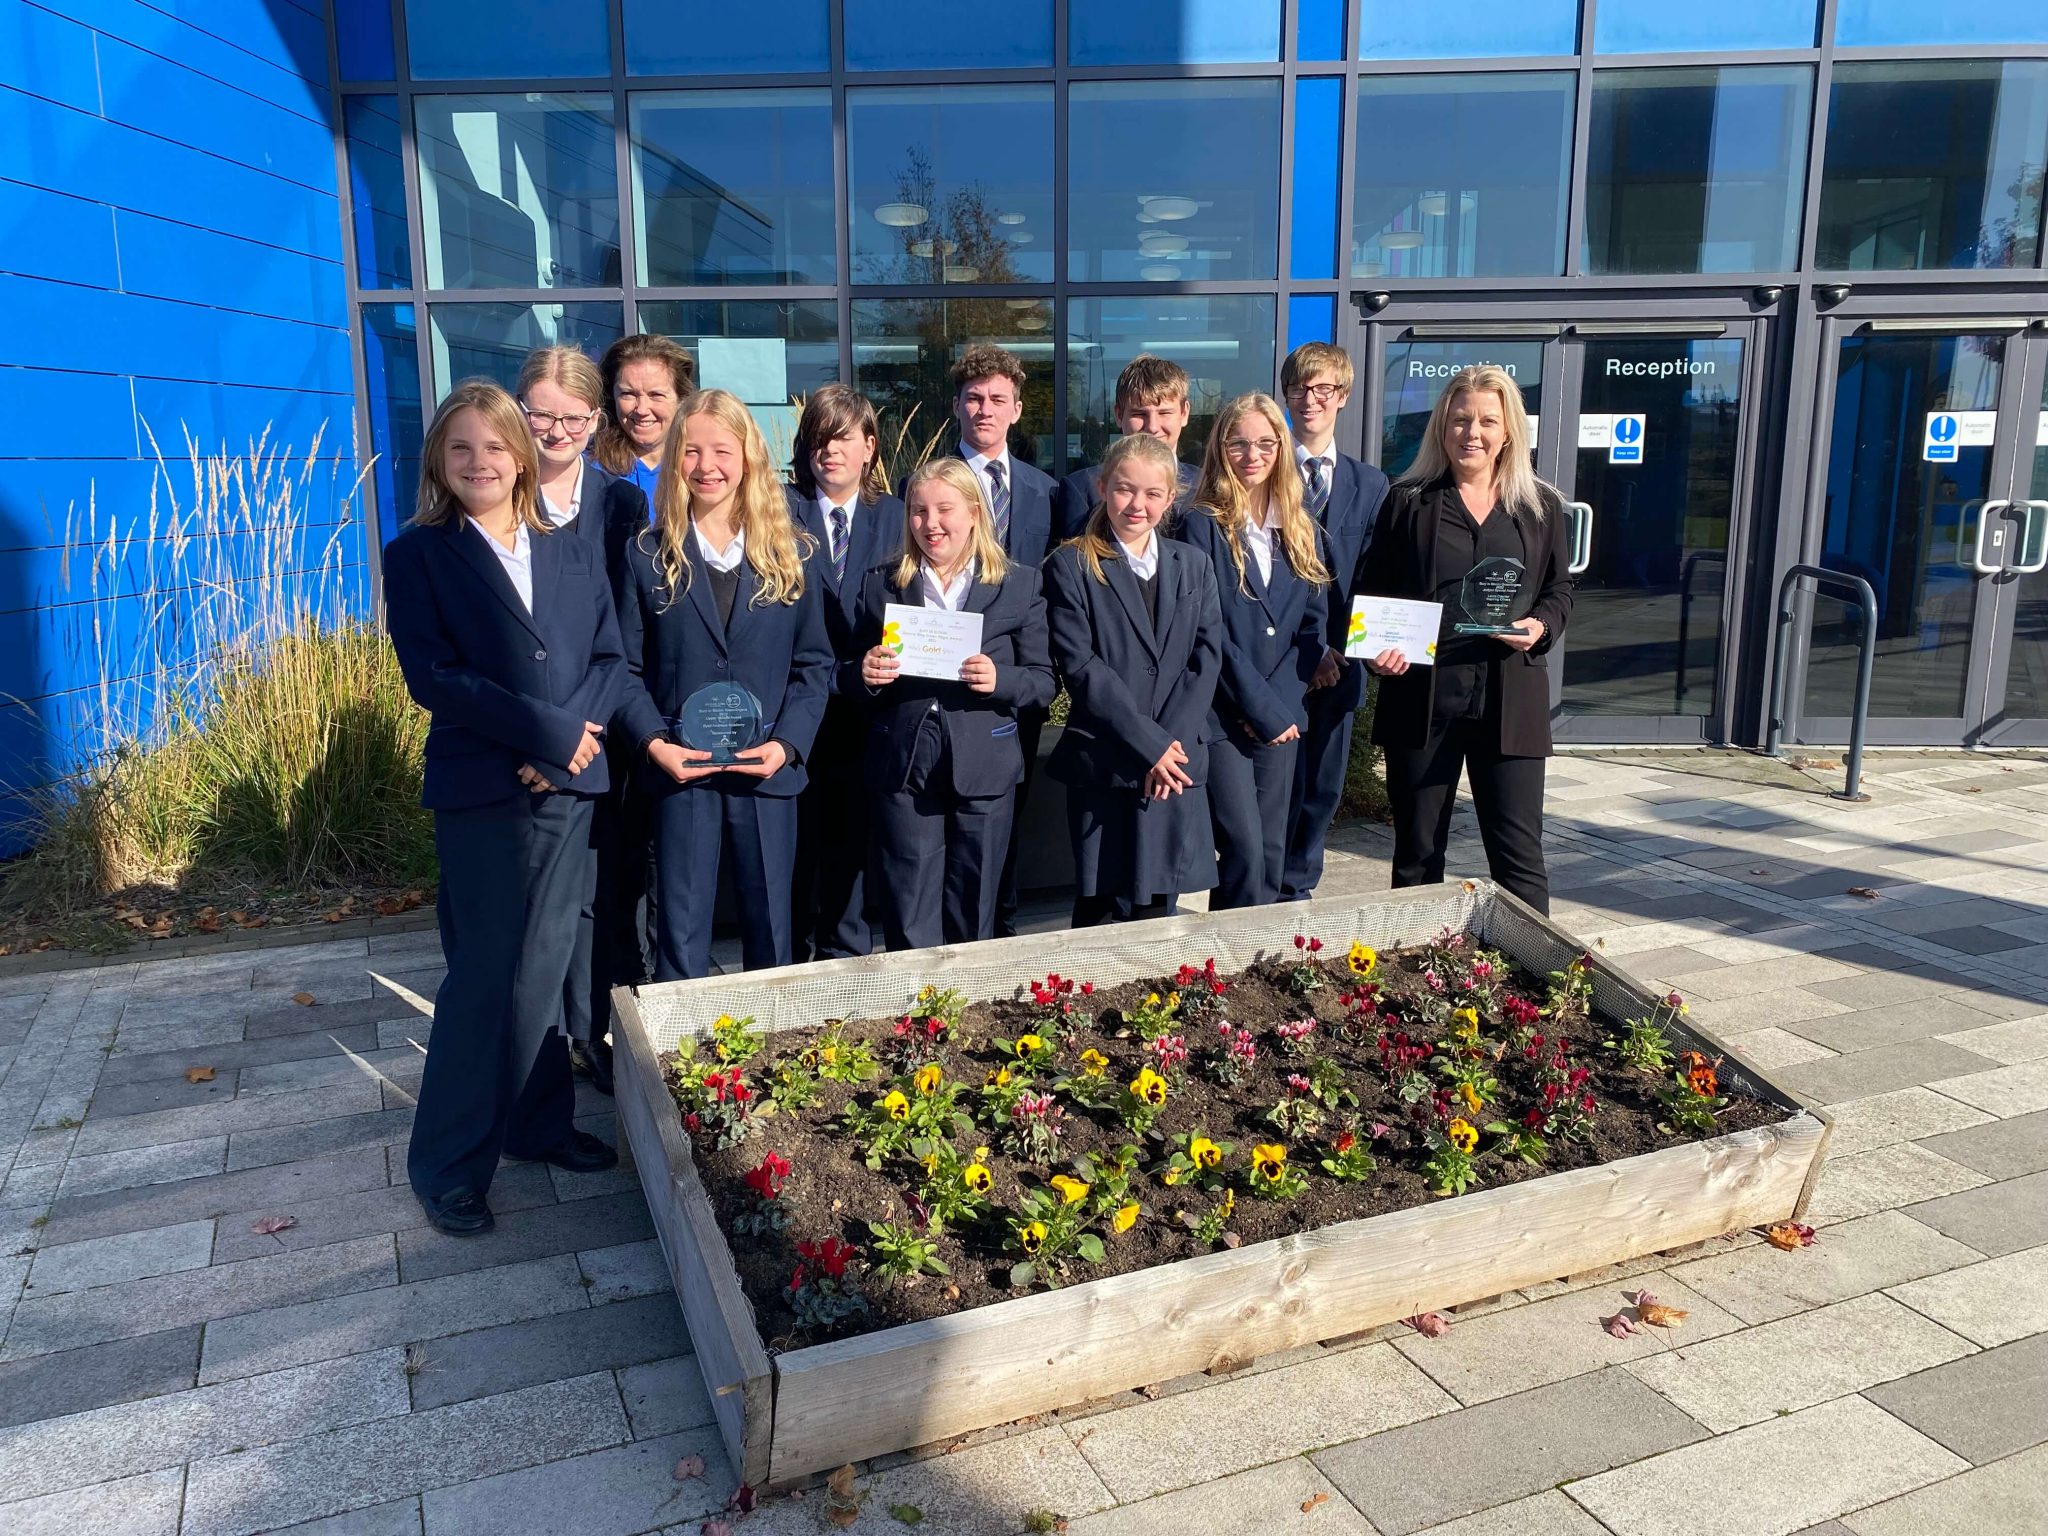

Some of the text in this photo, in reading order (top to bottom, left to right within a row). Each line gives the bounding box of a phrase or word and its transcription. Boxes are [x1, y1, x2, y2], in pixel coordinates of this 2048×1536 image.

[1408, 360, 1517, 378] Recen
[1606, 357, 1715, 379] Reception
[922, 645, 941, 654] Gold
